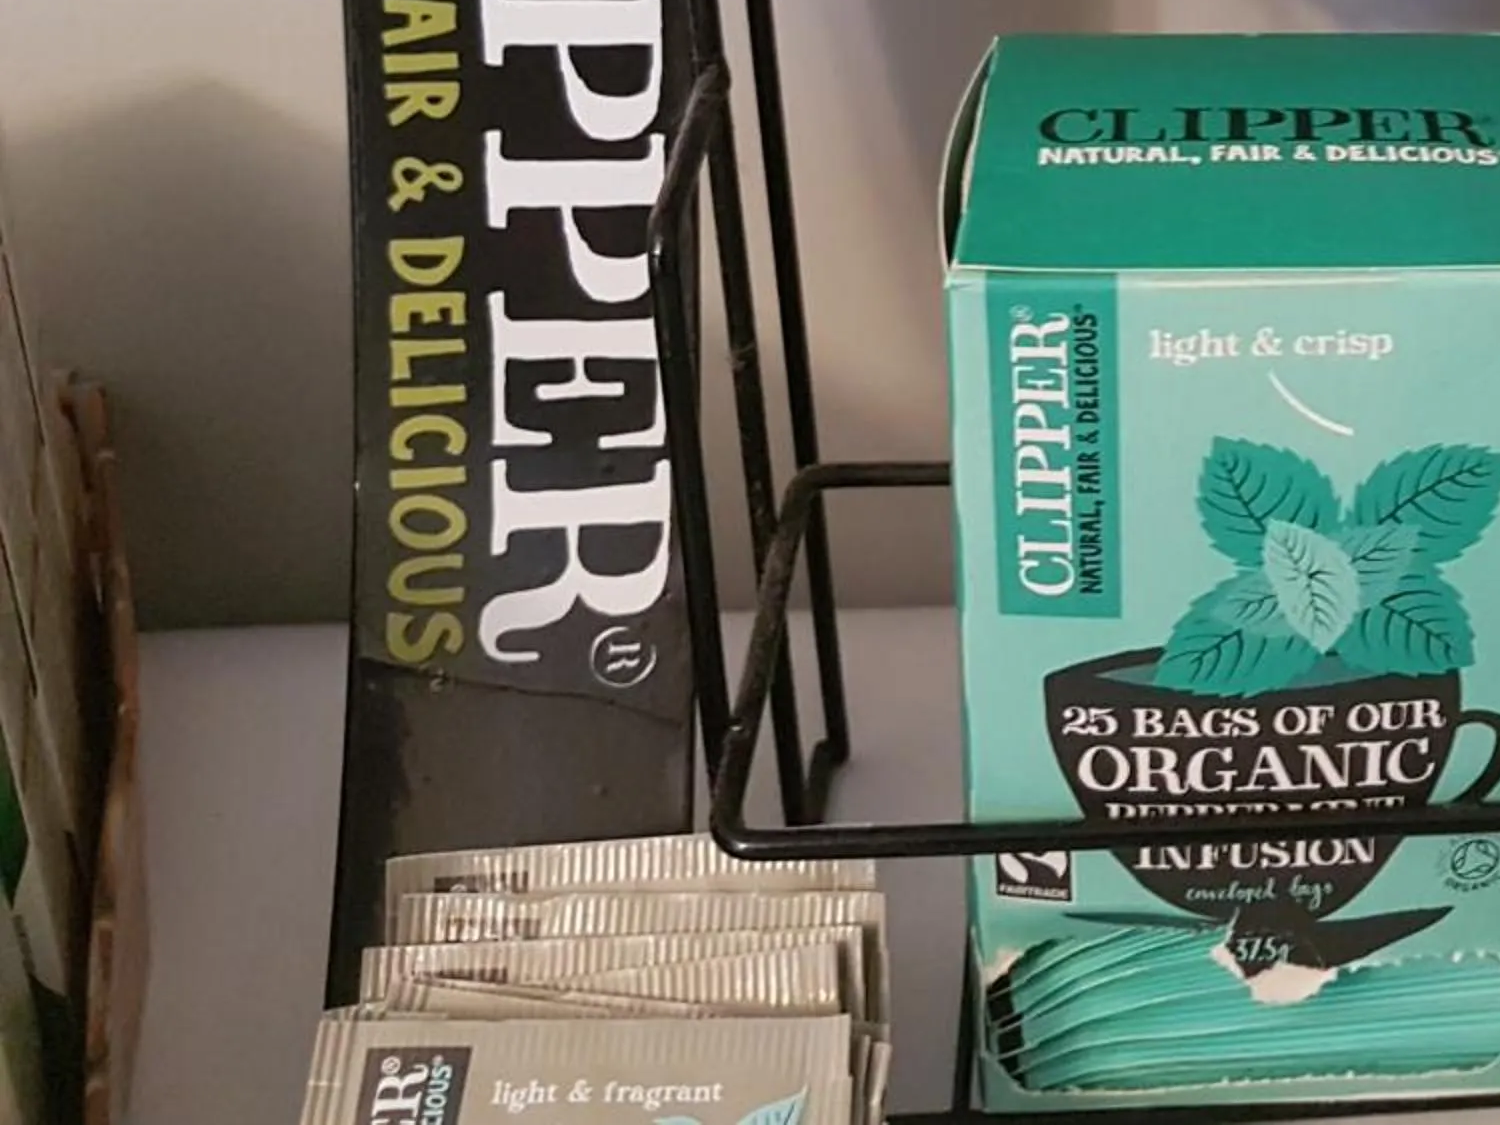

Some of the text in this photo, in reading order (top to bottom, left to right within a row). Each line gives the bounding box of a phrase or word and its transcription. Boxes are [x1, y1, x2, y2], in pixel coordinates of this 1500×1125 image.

[1037, 106, 1497, 148] CLIPPER
[1038, 144, 1499, 167] NATURAL, FAIR & DELICIOUS
[387, 156, 463, 212] &
[1149, 327, 1394, 366] light & crisp
[385, 236, 468, 665] DELICIOUS
[1073, 312, 1105, 595] NATURAL, FAIR & DELICIOUS
[1061, 698, 1448, 740] 25 BAGS OF OUR
[1077, 738, 1437, 796] ORGANIC
[1132, 836, 1377, 871] INFUSION
[490, 1078, 725, 1114] light & fragrant
